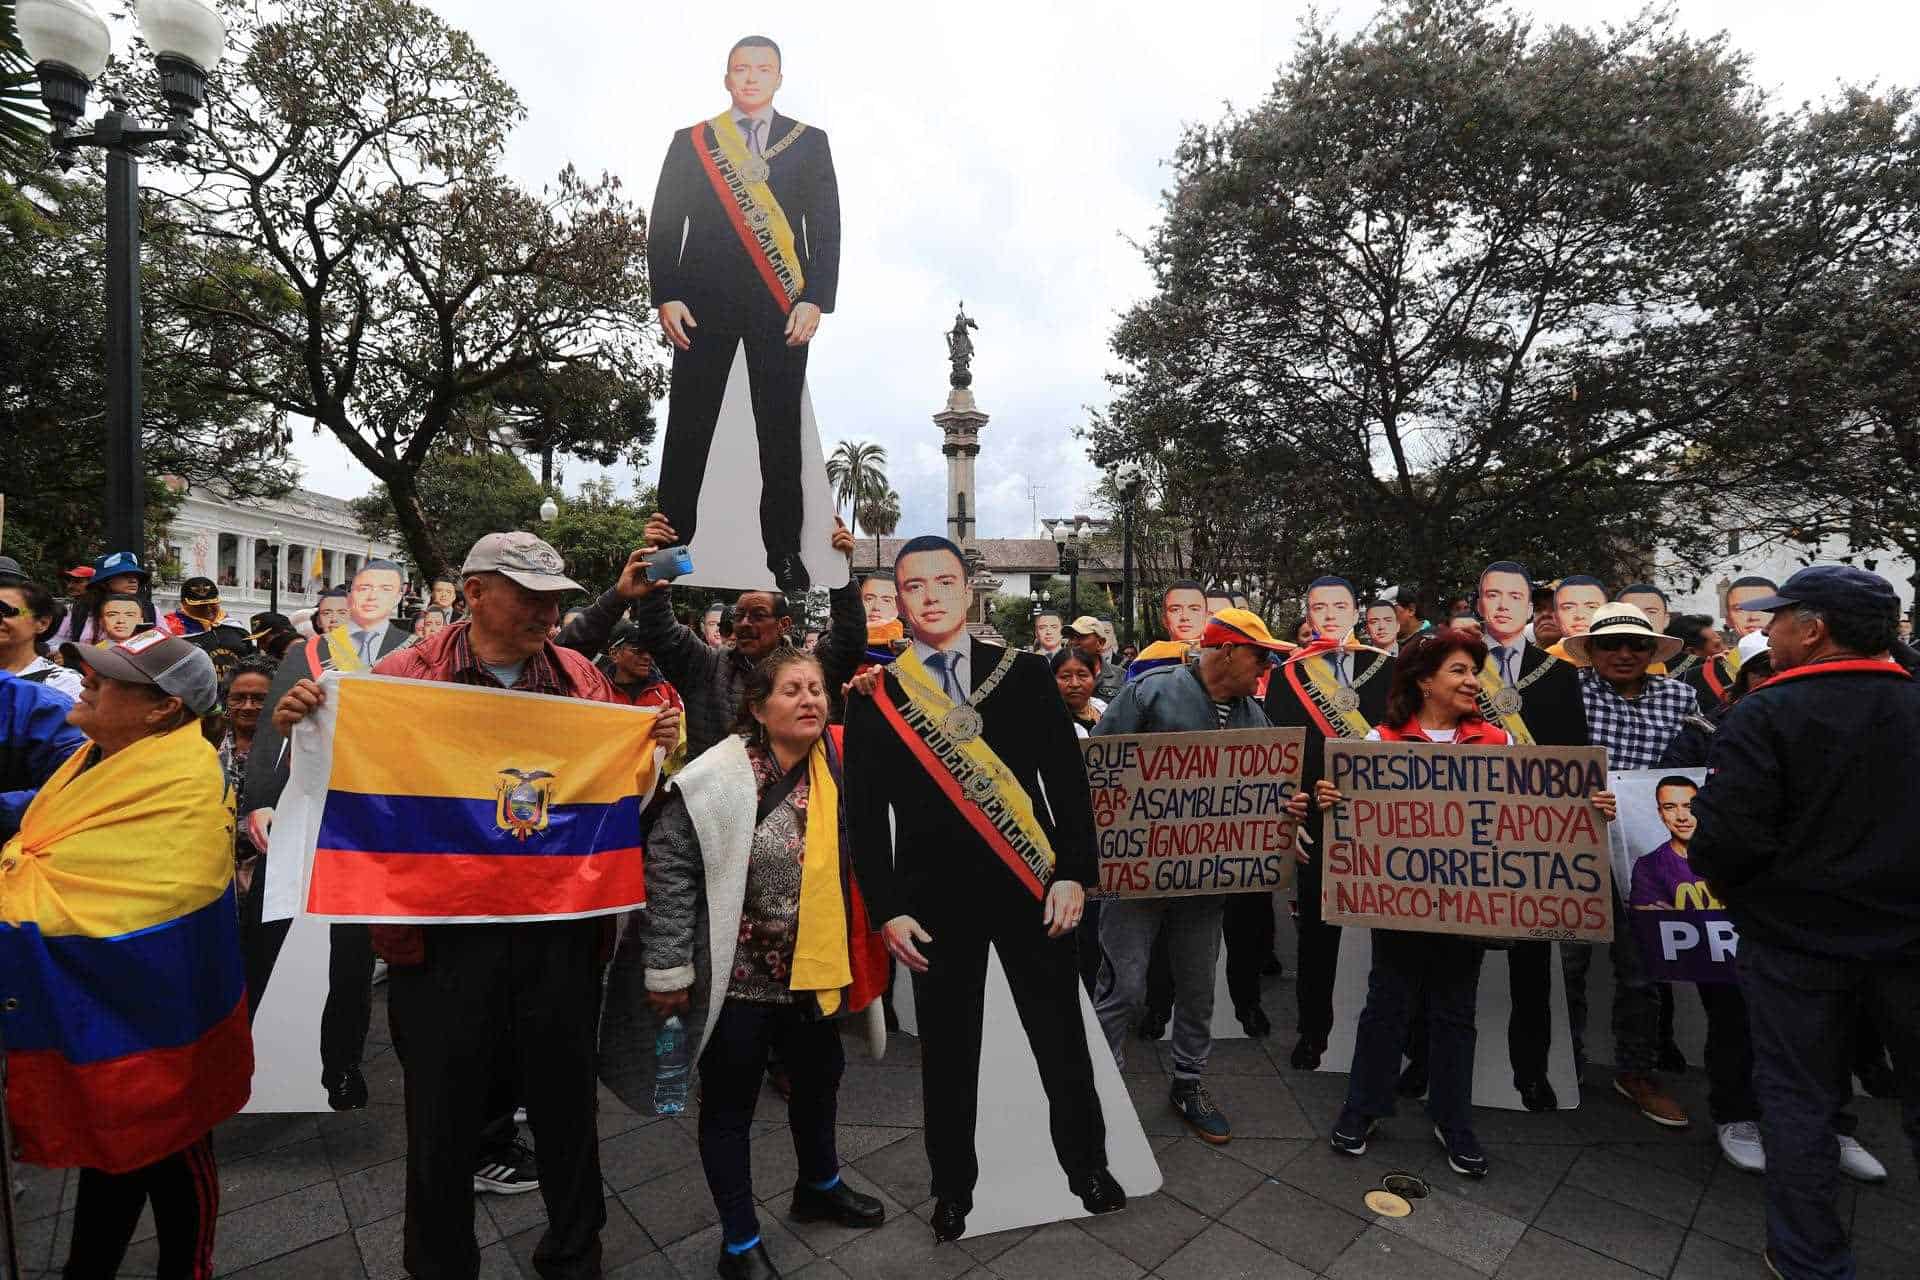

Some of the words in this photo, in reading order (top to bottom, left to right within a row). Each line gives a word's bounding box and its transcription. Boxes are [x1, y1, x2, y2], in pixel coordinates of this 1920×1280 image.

[1087, 742, 1139, 769] QUE
[1137, 744, 1218, 781] VAYAN
[1224, 742, 1299, 778] TODOS
[1090, 769, 1123, 788] SE
[1332, 749, 1504, 793] PRESIDENTE
[1506, 756, 1606, 799] NOBOA
[1129, 779, 1297, 821] ASAMBLEISTAS
[1146, 820, 1293, 858] IGNORANTES
[1354, 799, 1465, 839] PUEBLO
[1495, 804, 1598, 844] APOYA
[1154, 854, 1281, 891] GOLPISTAS
[1328, 841, 1382, 877] SIN
[1386, 845, 1601, 893] CORREISTAS
